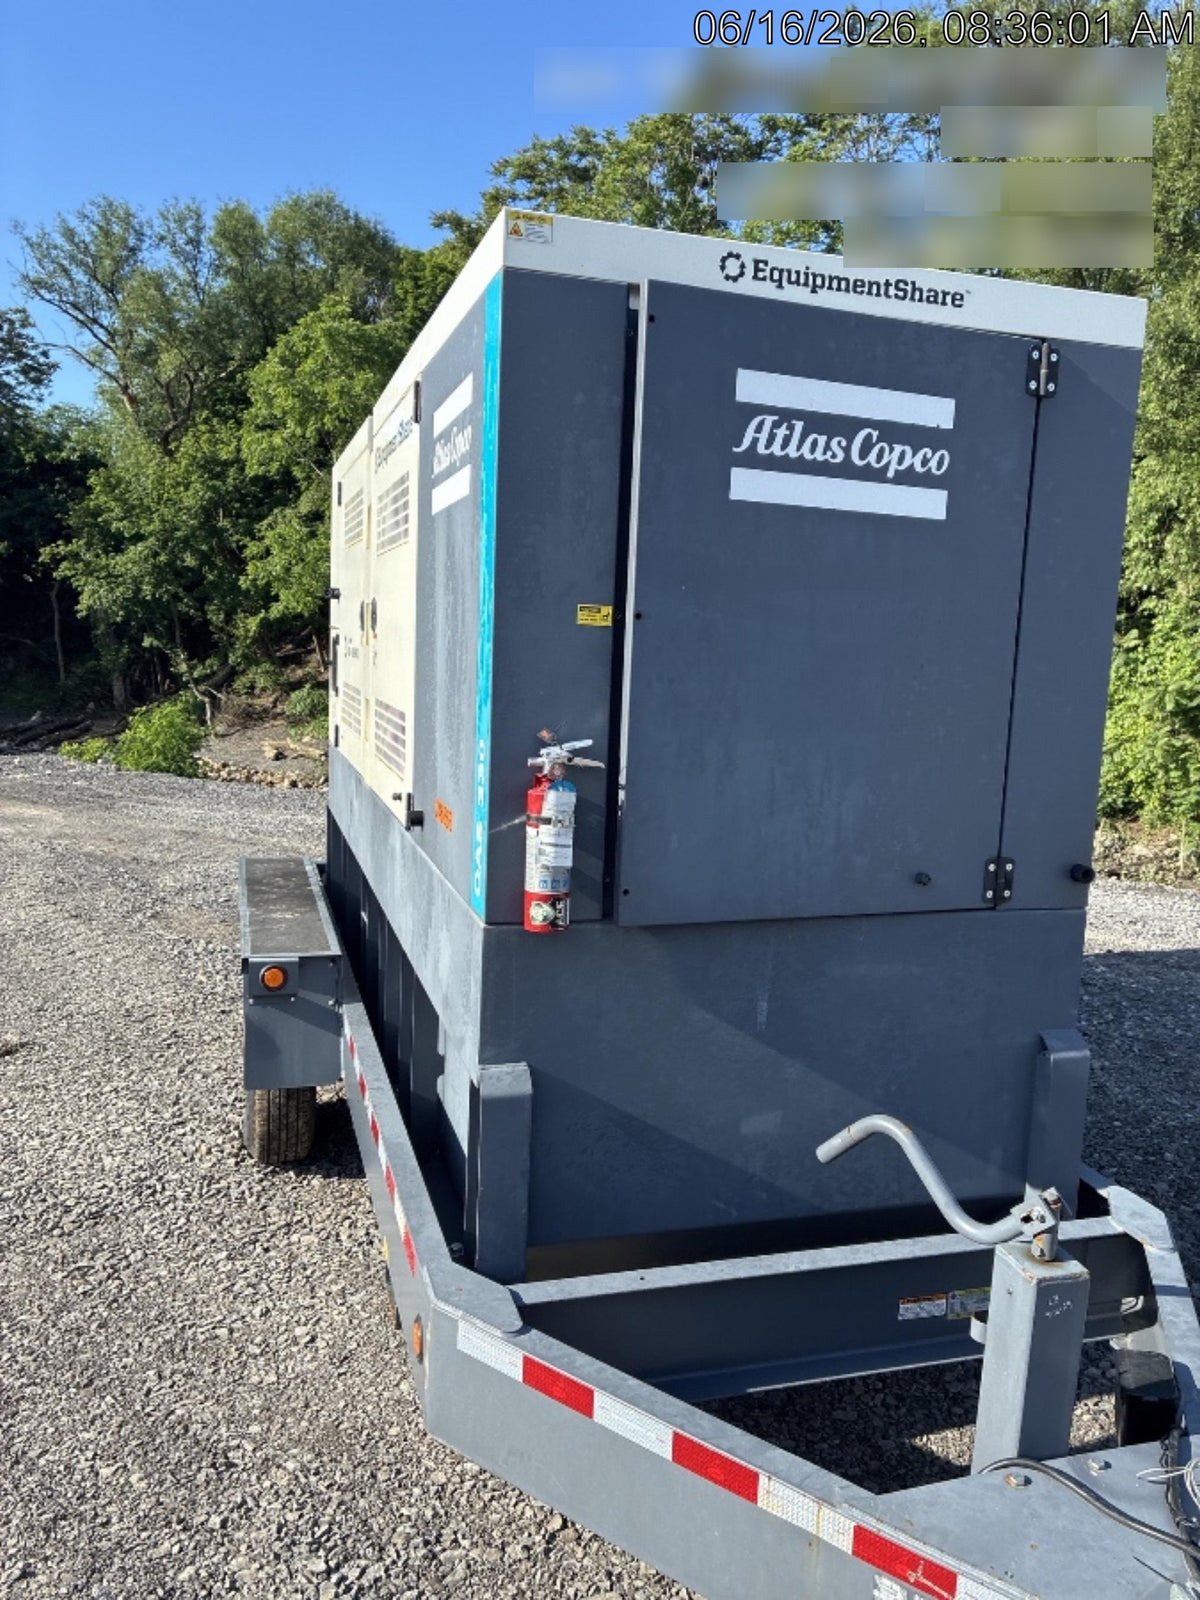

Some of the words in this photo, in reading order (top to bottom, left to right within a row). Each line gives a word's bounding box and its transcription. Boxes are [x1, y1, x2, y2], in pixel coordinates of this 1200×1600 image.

[751, 258, 965, 309] EquipmentShare
[732, 414, 847, 463] Atlas
[851, 428, 950, 478] Copco
